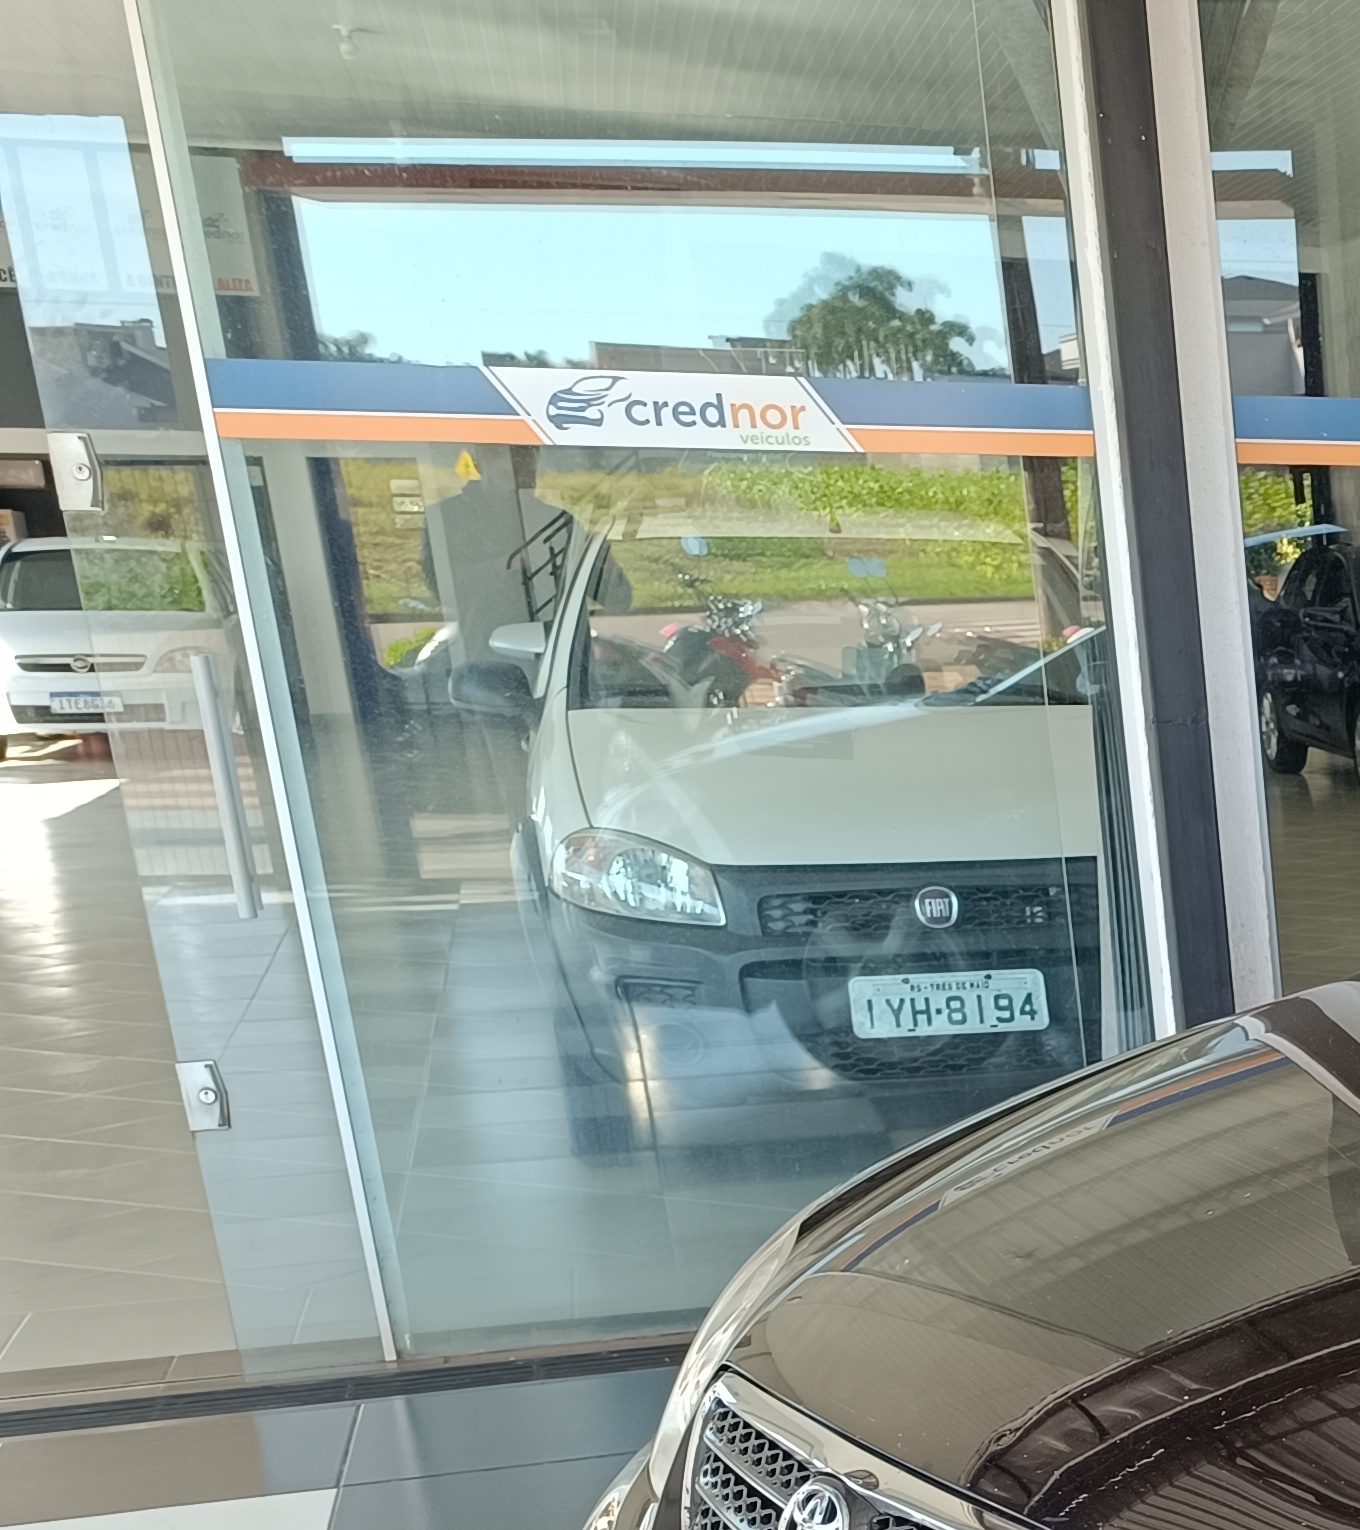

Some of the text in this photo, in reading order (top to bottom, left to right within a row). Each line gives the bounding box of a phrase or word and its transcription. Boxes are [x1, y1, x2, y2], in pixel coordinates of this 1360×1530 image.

[624, 393, 807, 430] crednor
[740, 431, 811, 446] veículos
[924, 898, 950, 918] FIAT
